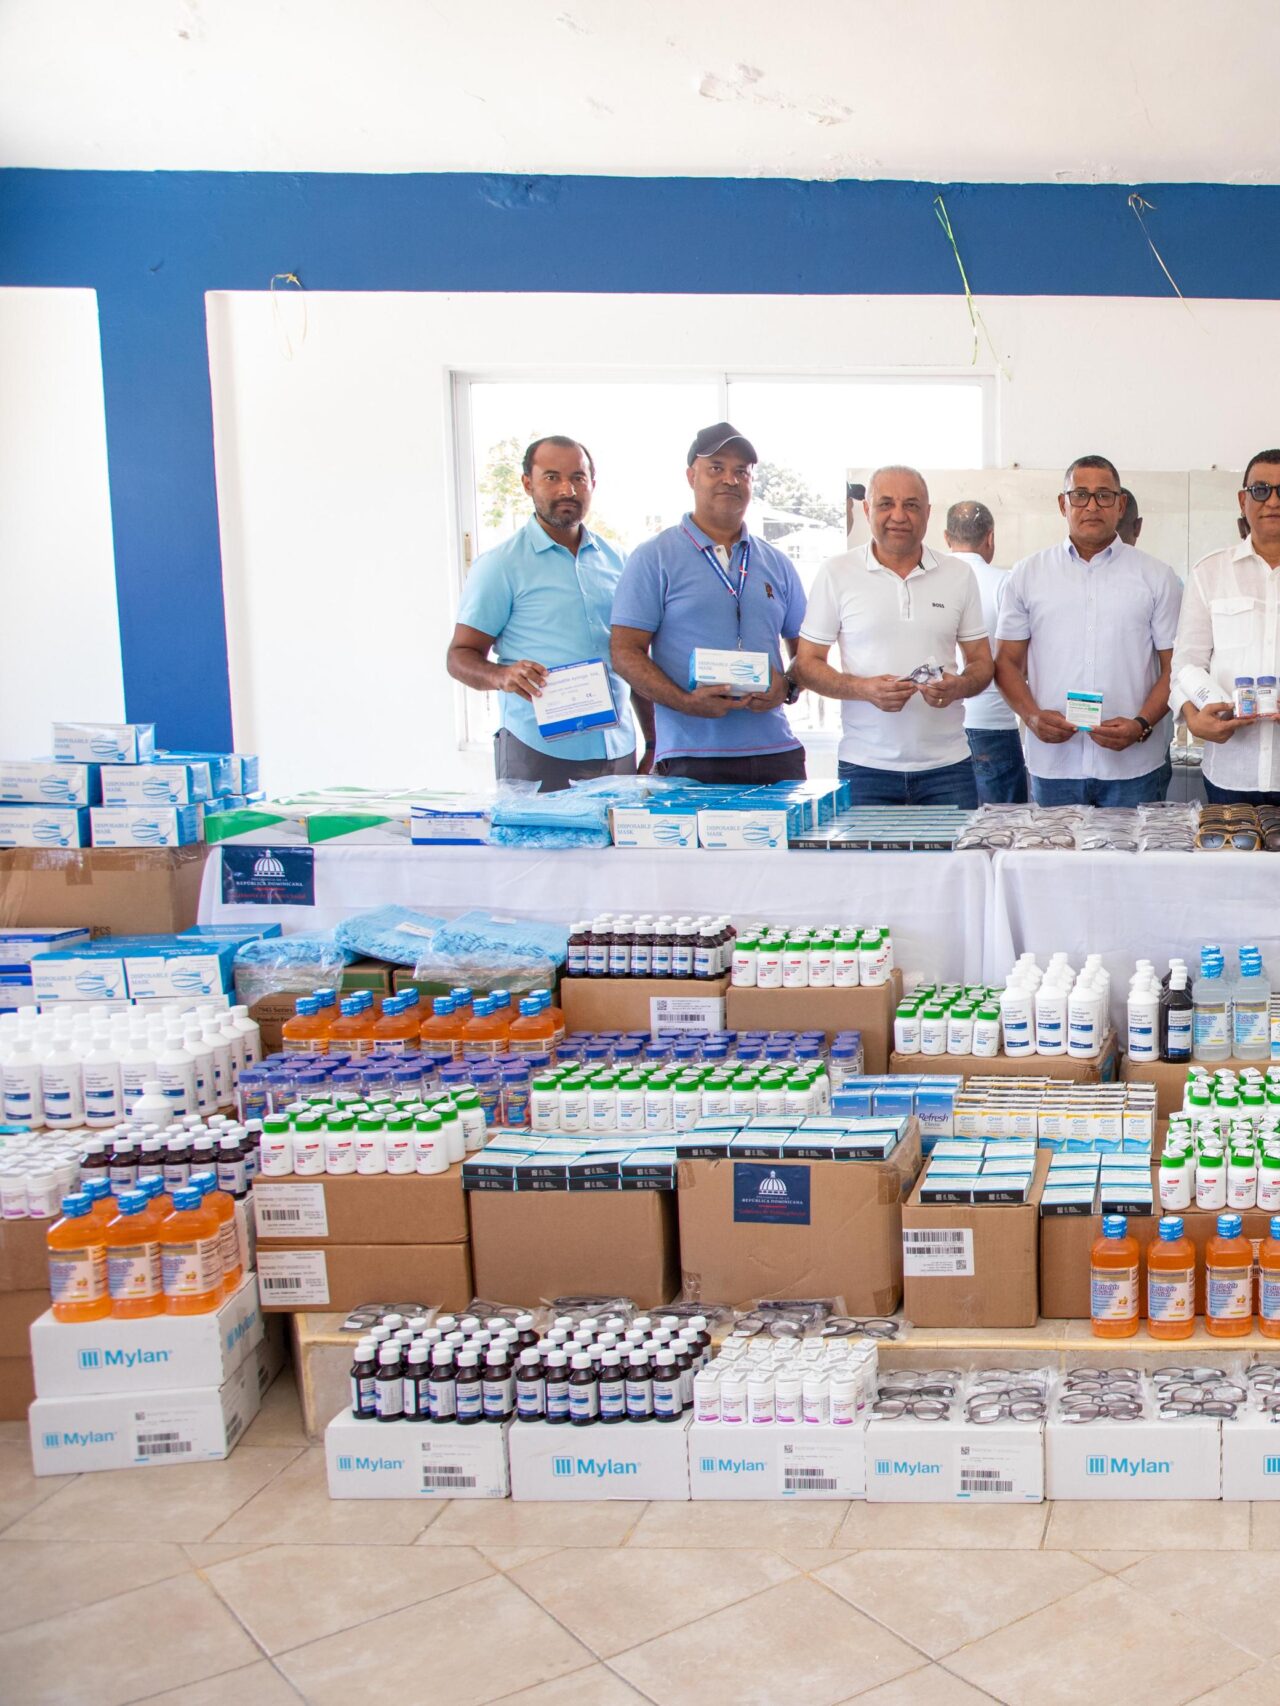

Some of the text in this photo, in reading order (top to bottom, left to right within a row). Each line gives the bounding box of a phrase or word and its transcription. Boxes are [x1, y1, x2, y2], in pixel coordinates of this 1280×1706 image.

[93, 926, 112, 936] PCS
[918, 1112, 948, 1122] Refresh
[104, 1347, 168, 1369] Mylan
[63, 1429, 115, 1447] Mylan
[356, 1455, 403, 1474] Mylan
[577, 1457, 639, 1478] Mylan
[718, 1457, 766, 1474] Mylan
[893, 1459, 940, 1477] Mylan
[1110, 1456, 1171, 1477] Mylan
